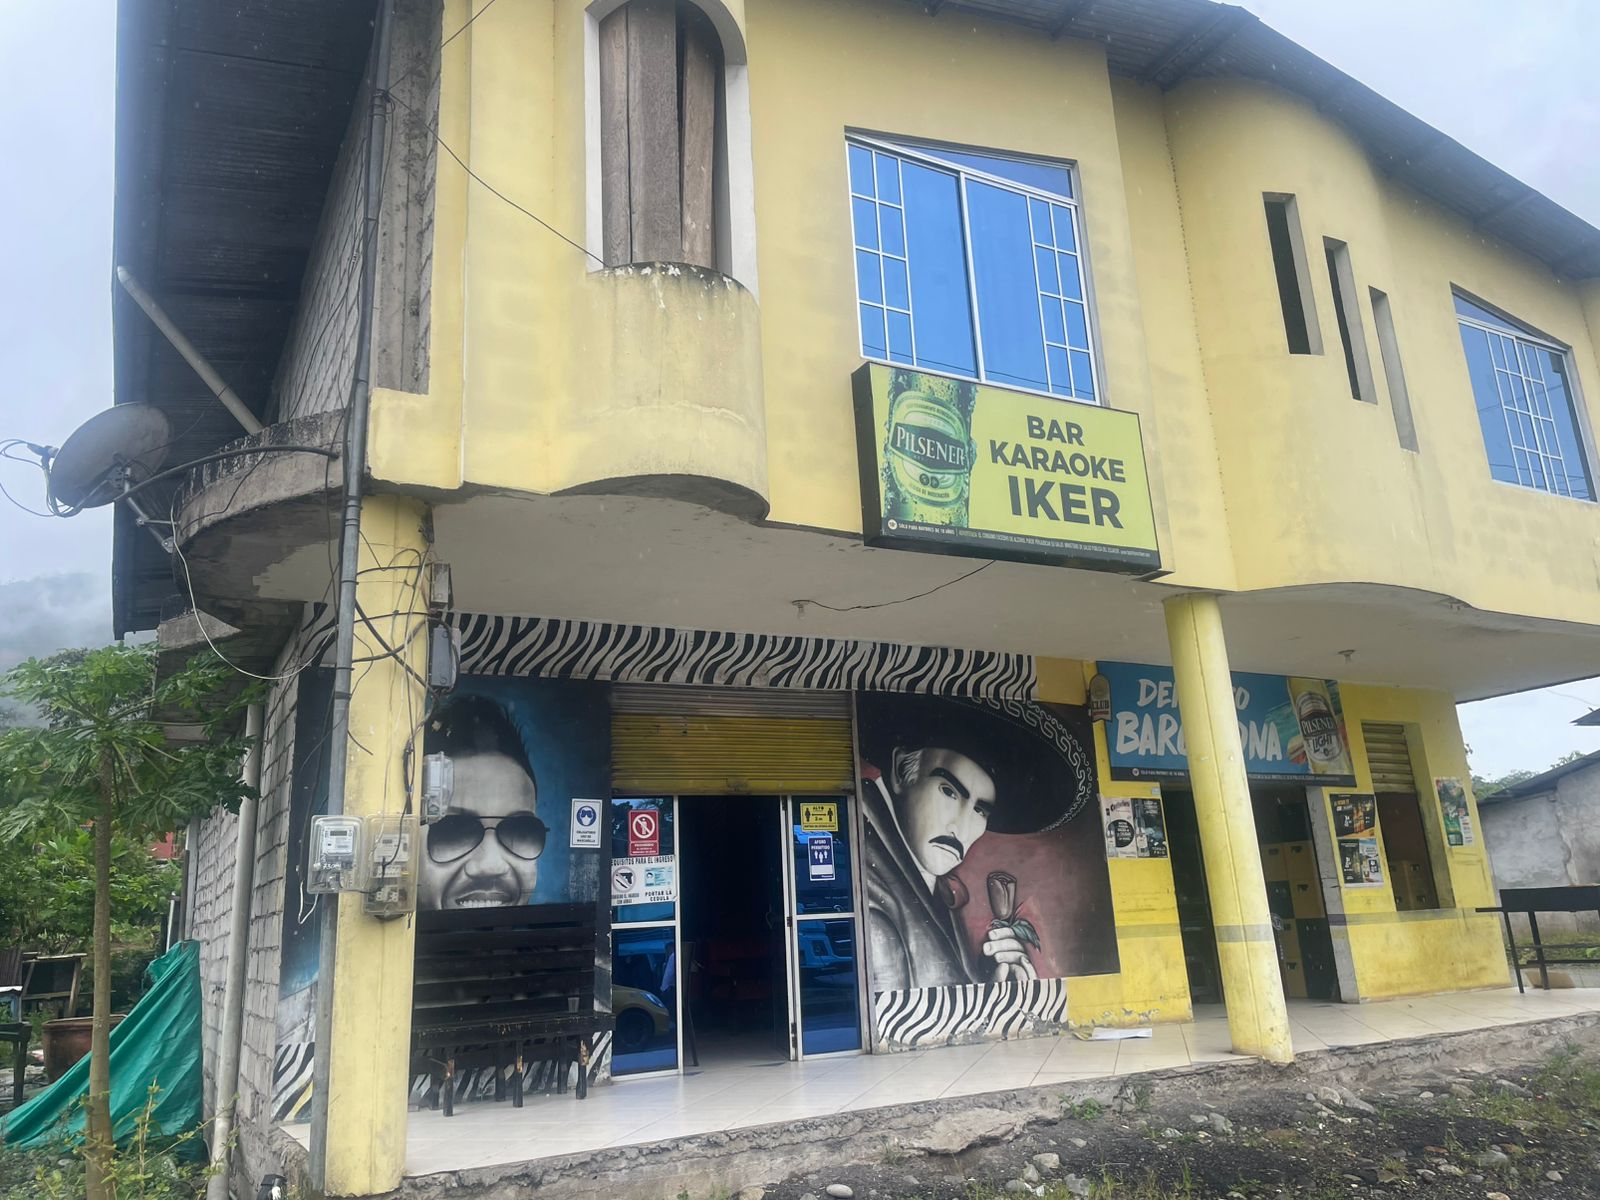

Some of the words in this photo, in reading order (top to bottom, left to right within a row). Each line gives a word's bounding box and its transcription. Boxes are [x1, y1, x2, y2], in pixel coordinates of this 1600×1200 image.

[896, 426, 966, 466] PILSENER
[1026, 415, 1085, 446] BAR
[990, 439, 1126, 483] KARAOKE
[1008, 475, 1124, 529] IKER
[1116, 711, 1283, 762] BARONA
[611, 857, 635, 866] EQUISITOS
[636, 857, 647, 865] PARA
[647, 856, 654, 864] EL
[654, 855, 674, 863] INGRESO
